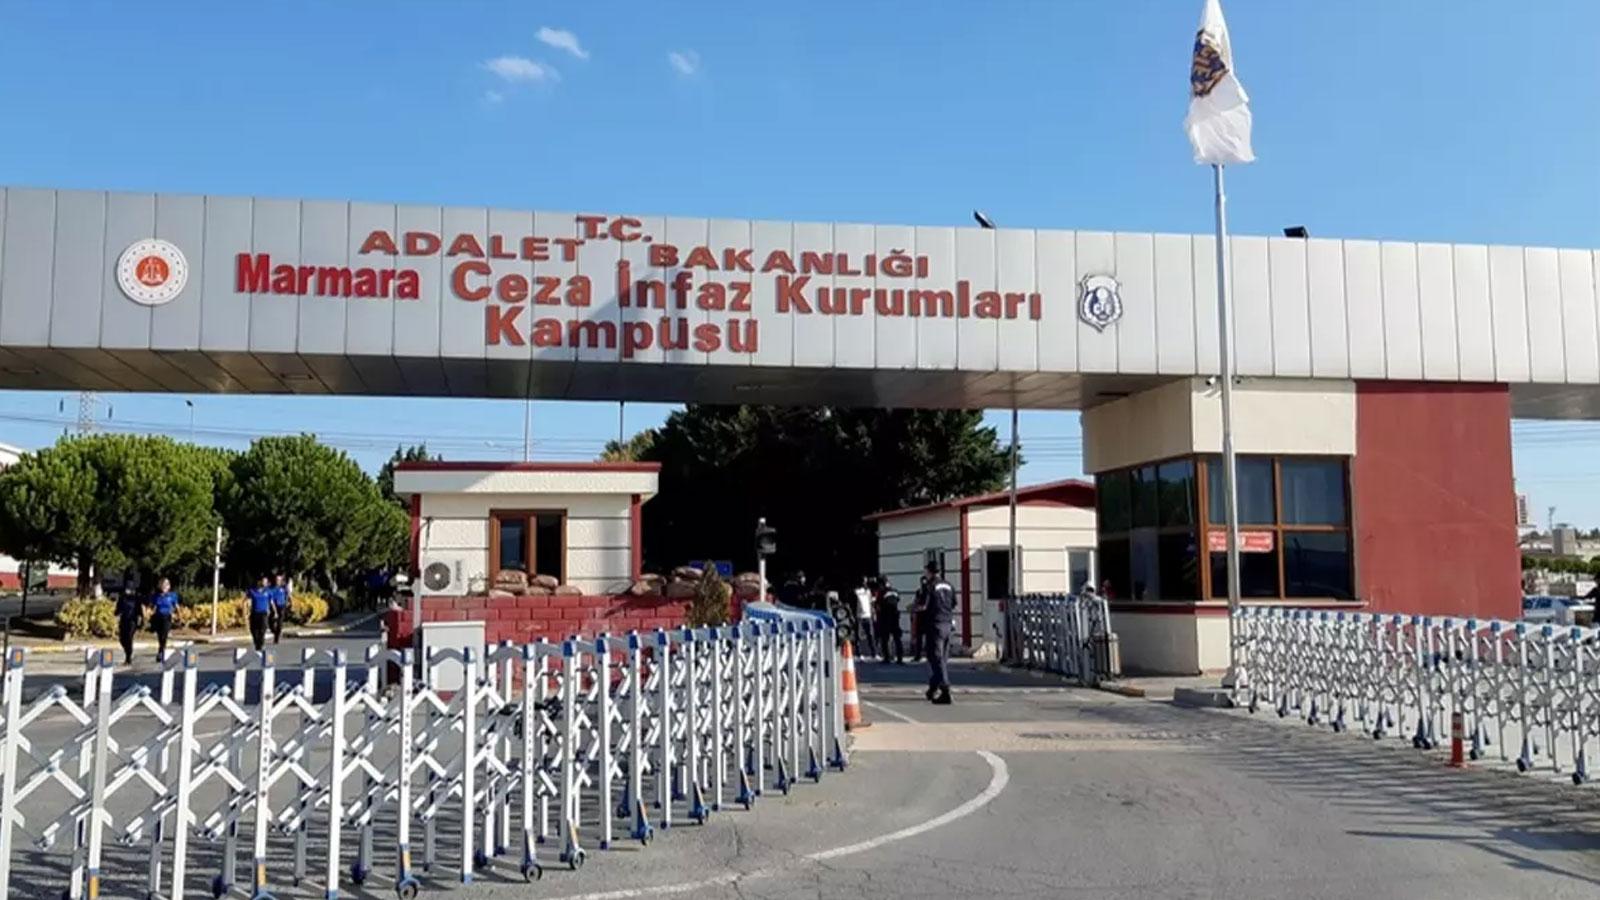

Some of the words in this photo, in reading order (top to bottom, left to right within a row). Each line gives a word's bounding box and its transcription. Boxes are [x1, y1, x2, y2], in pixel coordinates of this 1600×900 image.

[577, 213, 652, 242] T.C.
[361, 230, 584, 261] ADALET
[649, 244, 930, 277] BAKANLIĞI
[235, 252, 421, 300] Marmara
[450, 261, 592, 308] Ceza
[617, 259, 753, 312] İnfaz
[775, 274, 1042, 320] Kurumları
